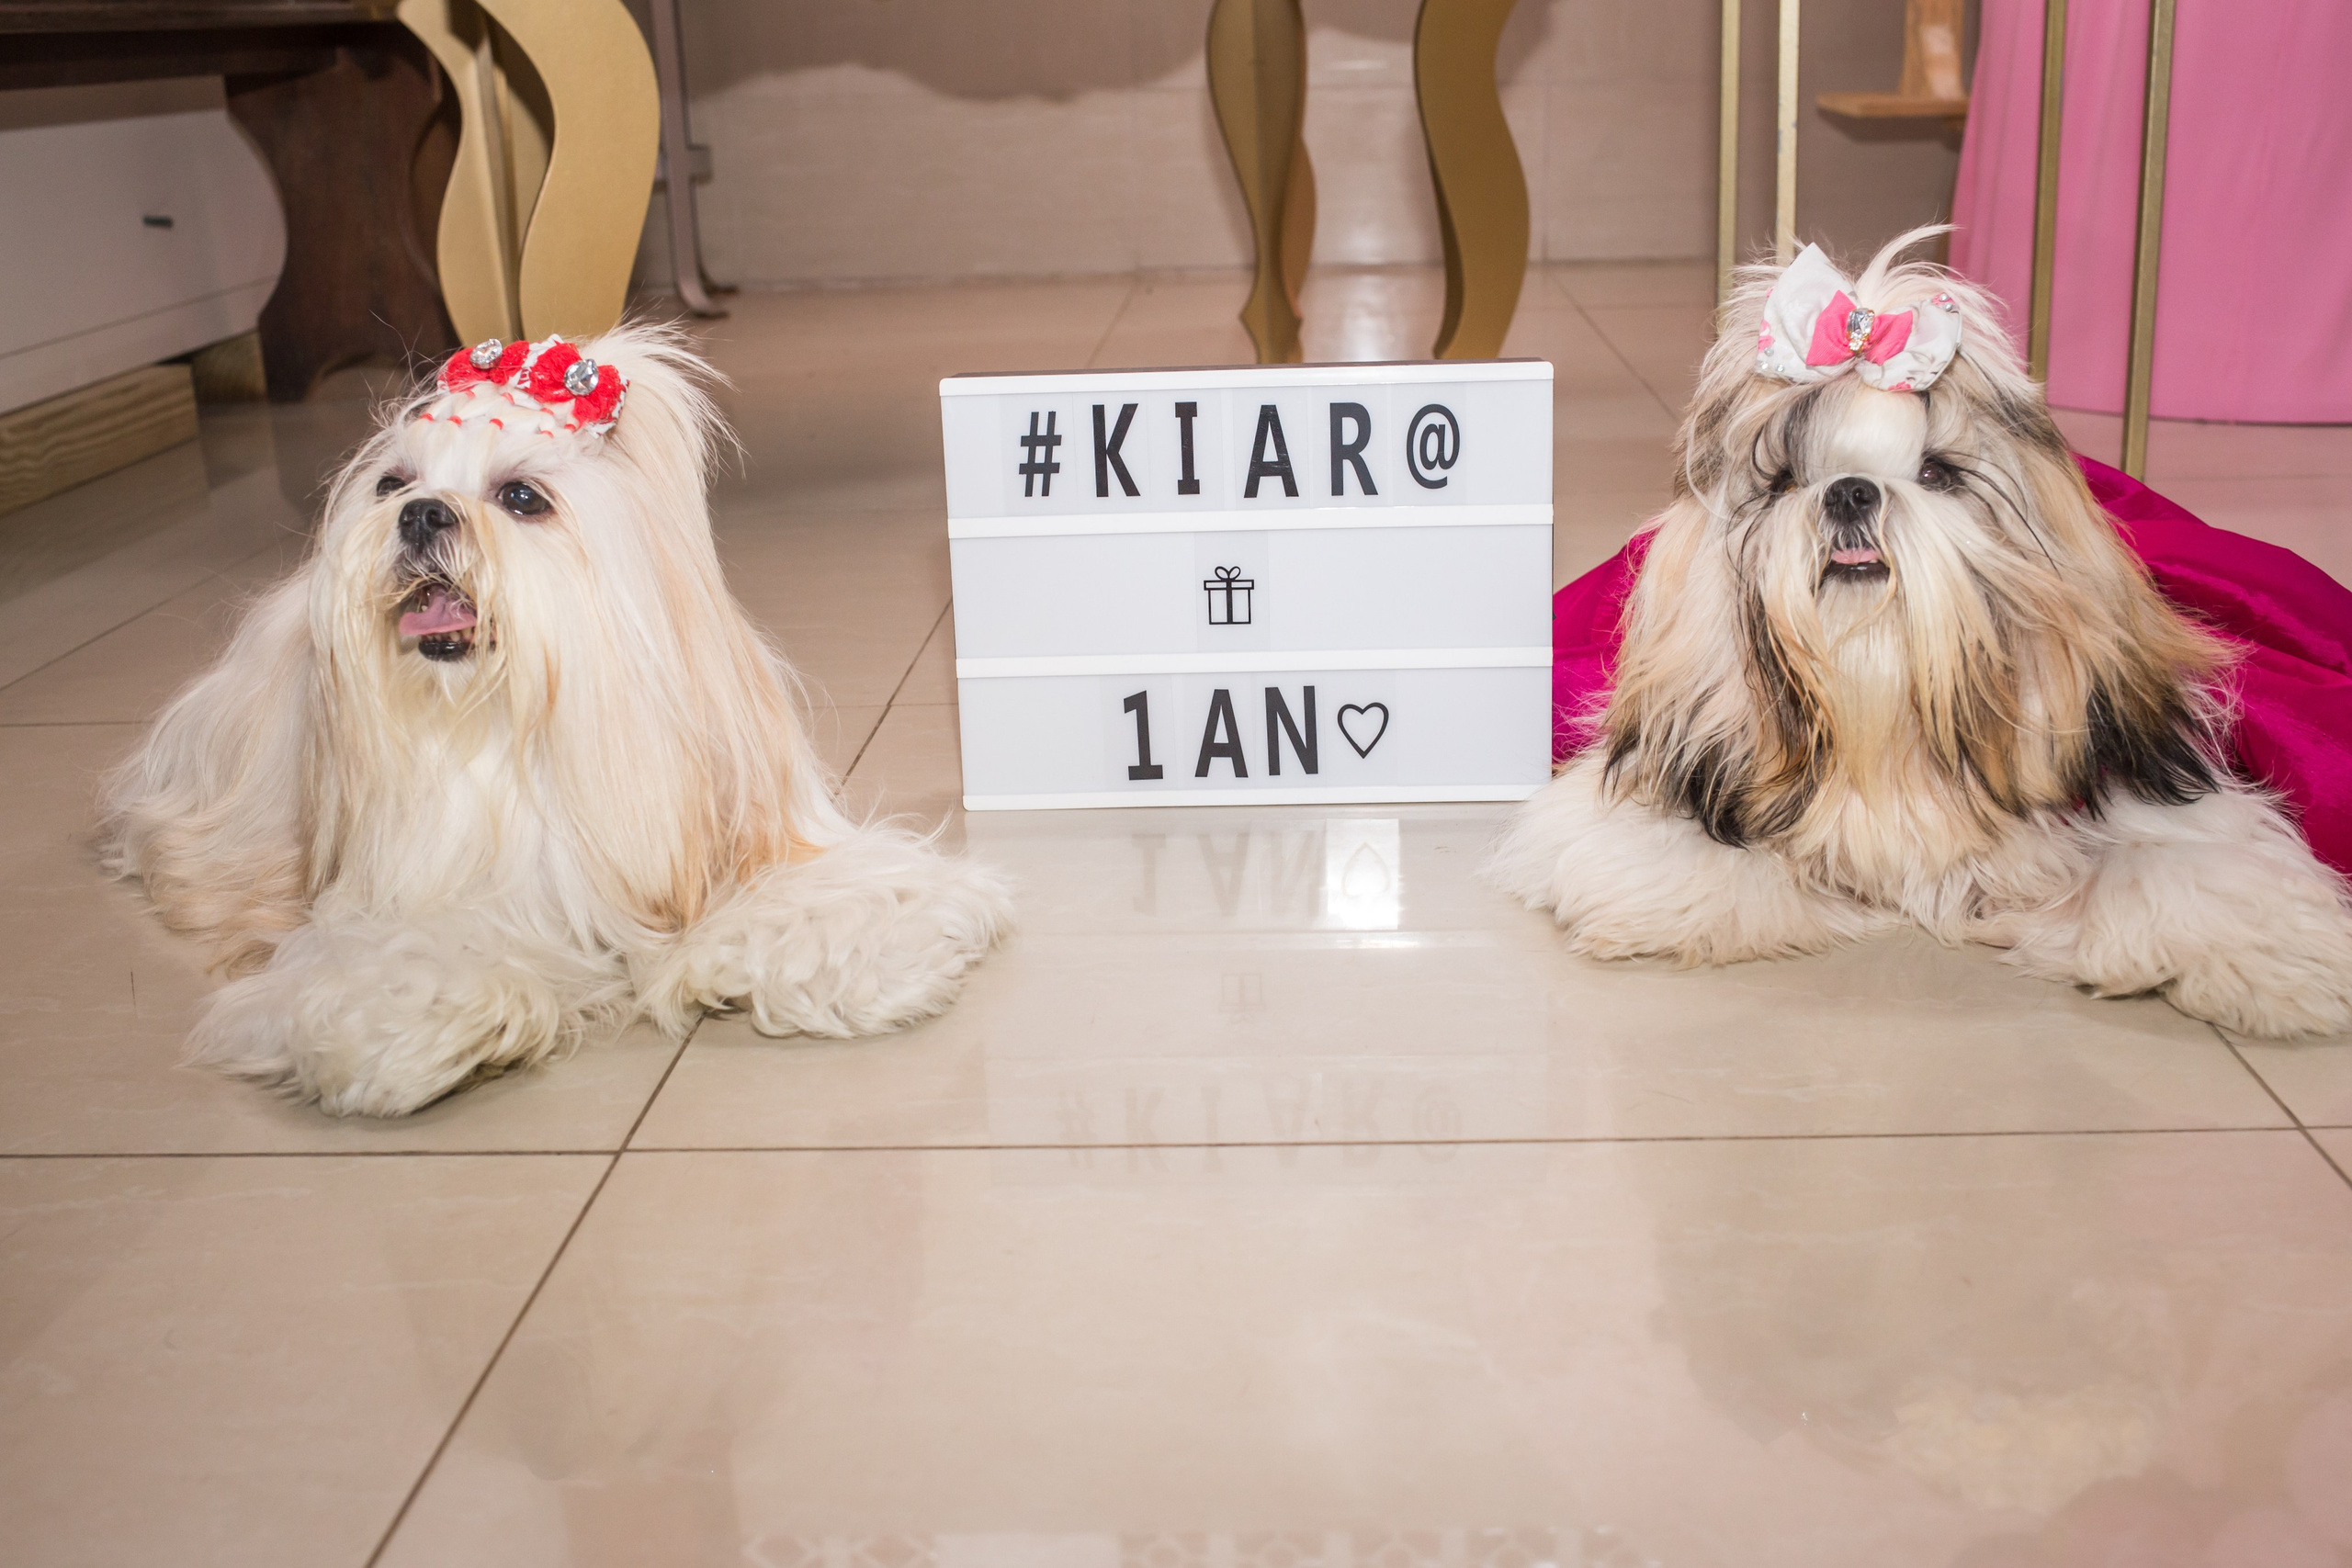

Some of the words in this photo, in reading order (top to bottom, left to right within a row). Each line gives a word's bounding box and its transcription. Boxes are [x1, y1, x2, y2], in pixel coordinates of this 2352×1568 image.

[1017, 401, 1462, 499] #KIAR@
[1123, 690, 1164, 781] 1
[1194, 685, 1318, 778] AN
